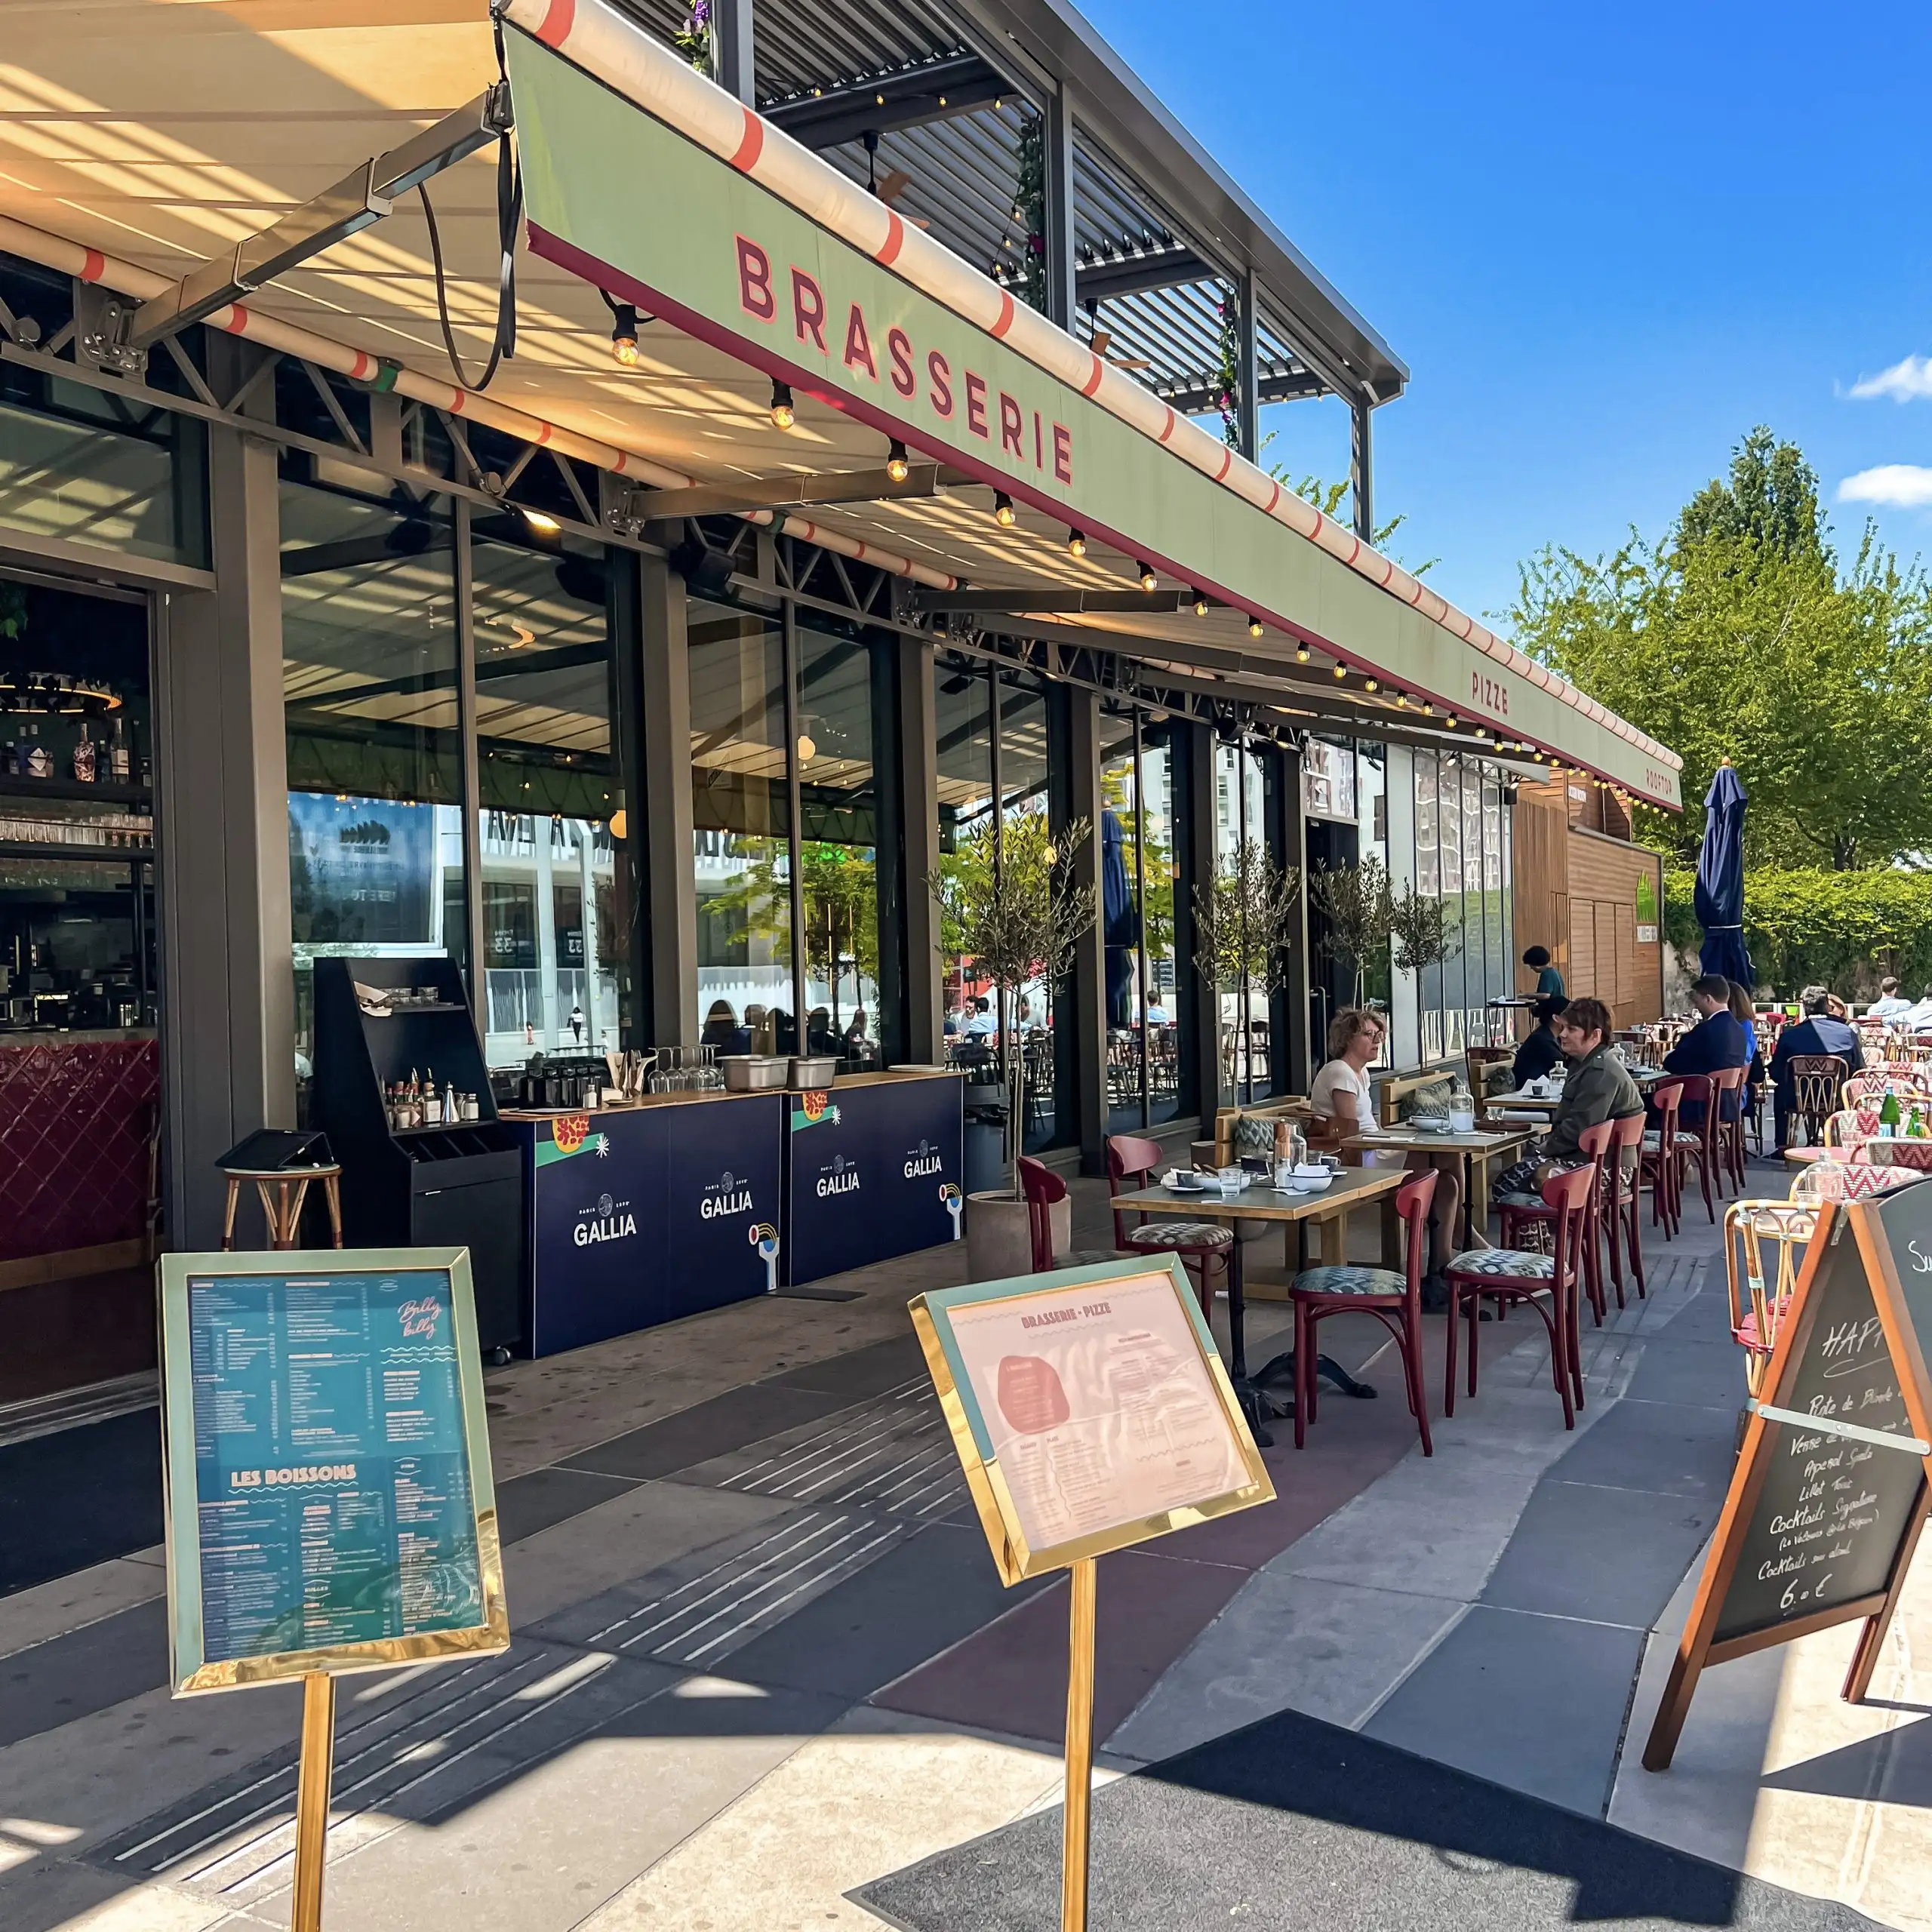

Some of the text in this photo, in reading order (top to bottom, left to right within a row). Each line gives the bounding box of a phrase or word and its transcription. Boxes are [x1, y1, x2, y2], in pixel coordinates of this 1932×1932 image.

[734, 232, 1073, 487] BRASSERIE
[1472, 670, 1508, 715] PIZZE
[1646, 768, 1672, 795] ROOFTOP
[904, 1155, 943, 1179] GALLIA
[817, 1171, 860, 1197] GALLIA
[700, 1190, 753, 1220] GALLIA
[574, 1214, 637, 1247] GALLIA
[397, 1296, 441, 1323] Billy
[1021, 1302, 1112, 1329] BRASSERIE PIZZE
[403, 1317, 435, 1340] billy
[231, 1464, 357, 1487] LES BOISSONS
[1770, 1502, 1826, 1535] Cocktails
[1758, 1552, 1807, 1580] Cocktails
